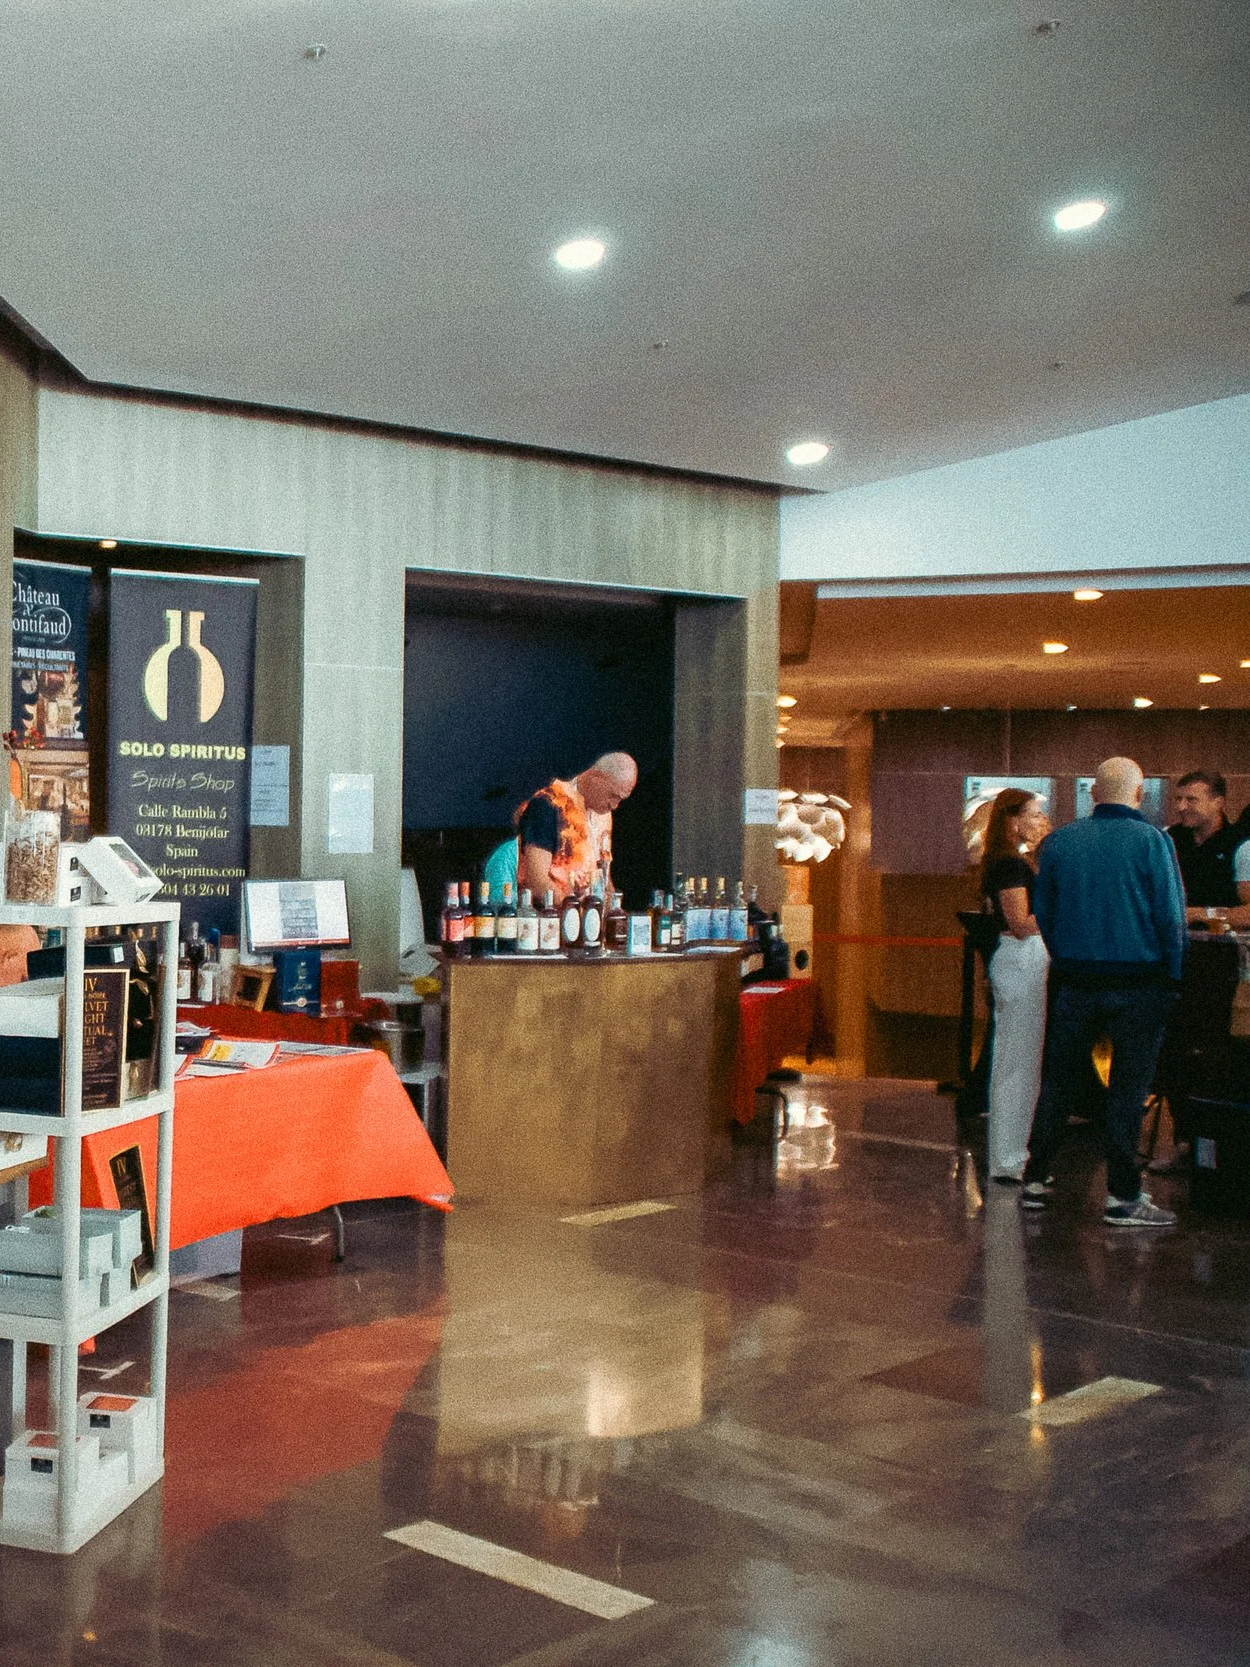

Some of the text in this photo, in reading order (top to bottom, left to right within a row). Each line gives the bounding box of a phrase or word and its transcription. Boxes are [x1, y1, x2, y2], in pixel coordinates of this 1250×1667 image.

[12, 614, 66, 636] ontifaud
[119, 740, 246, 760] SOLO SPIRITUS
[131, 770, 235, 793] Spirits Shop
[138, 803, 168, 818] Calle
[172, 804, 216, 819] Rambla
[176, 823, 230, 840] Benijófar
[165, 843, 199, 859] Spain
[182, 883, 196, 896] 43
[199, 883, 214, 896] 26
[216, 883, 230, 897] 01
[84, 977, 98, 992] IV
[84, 1001, 109, 1012] LVET
[84, 1013, 106, 1025] GHT
[83, 1025, 106, 1036] TUAL
